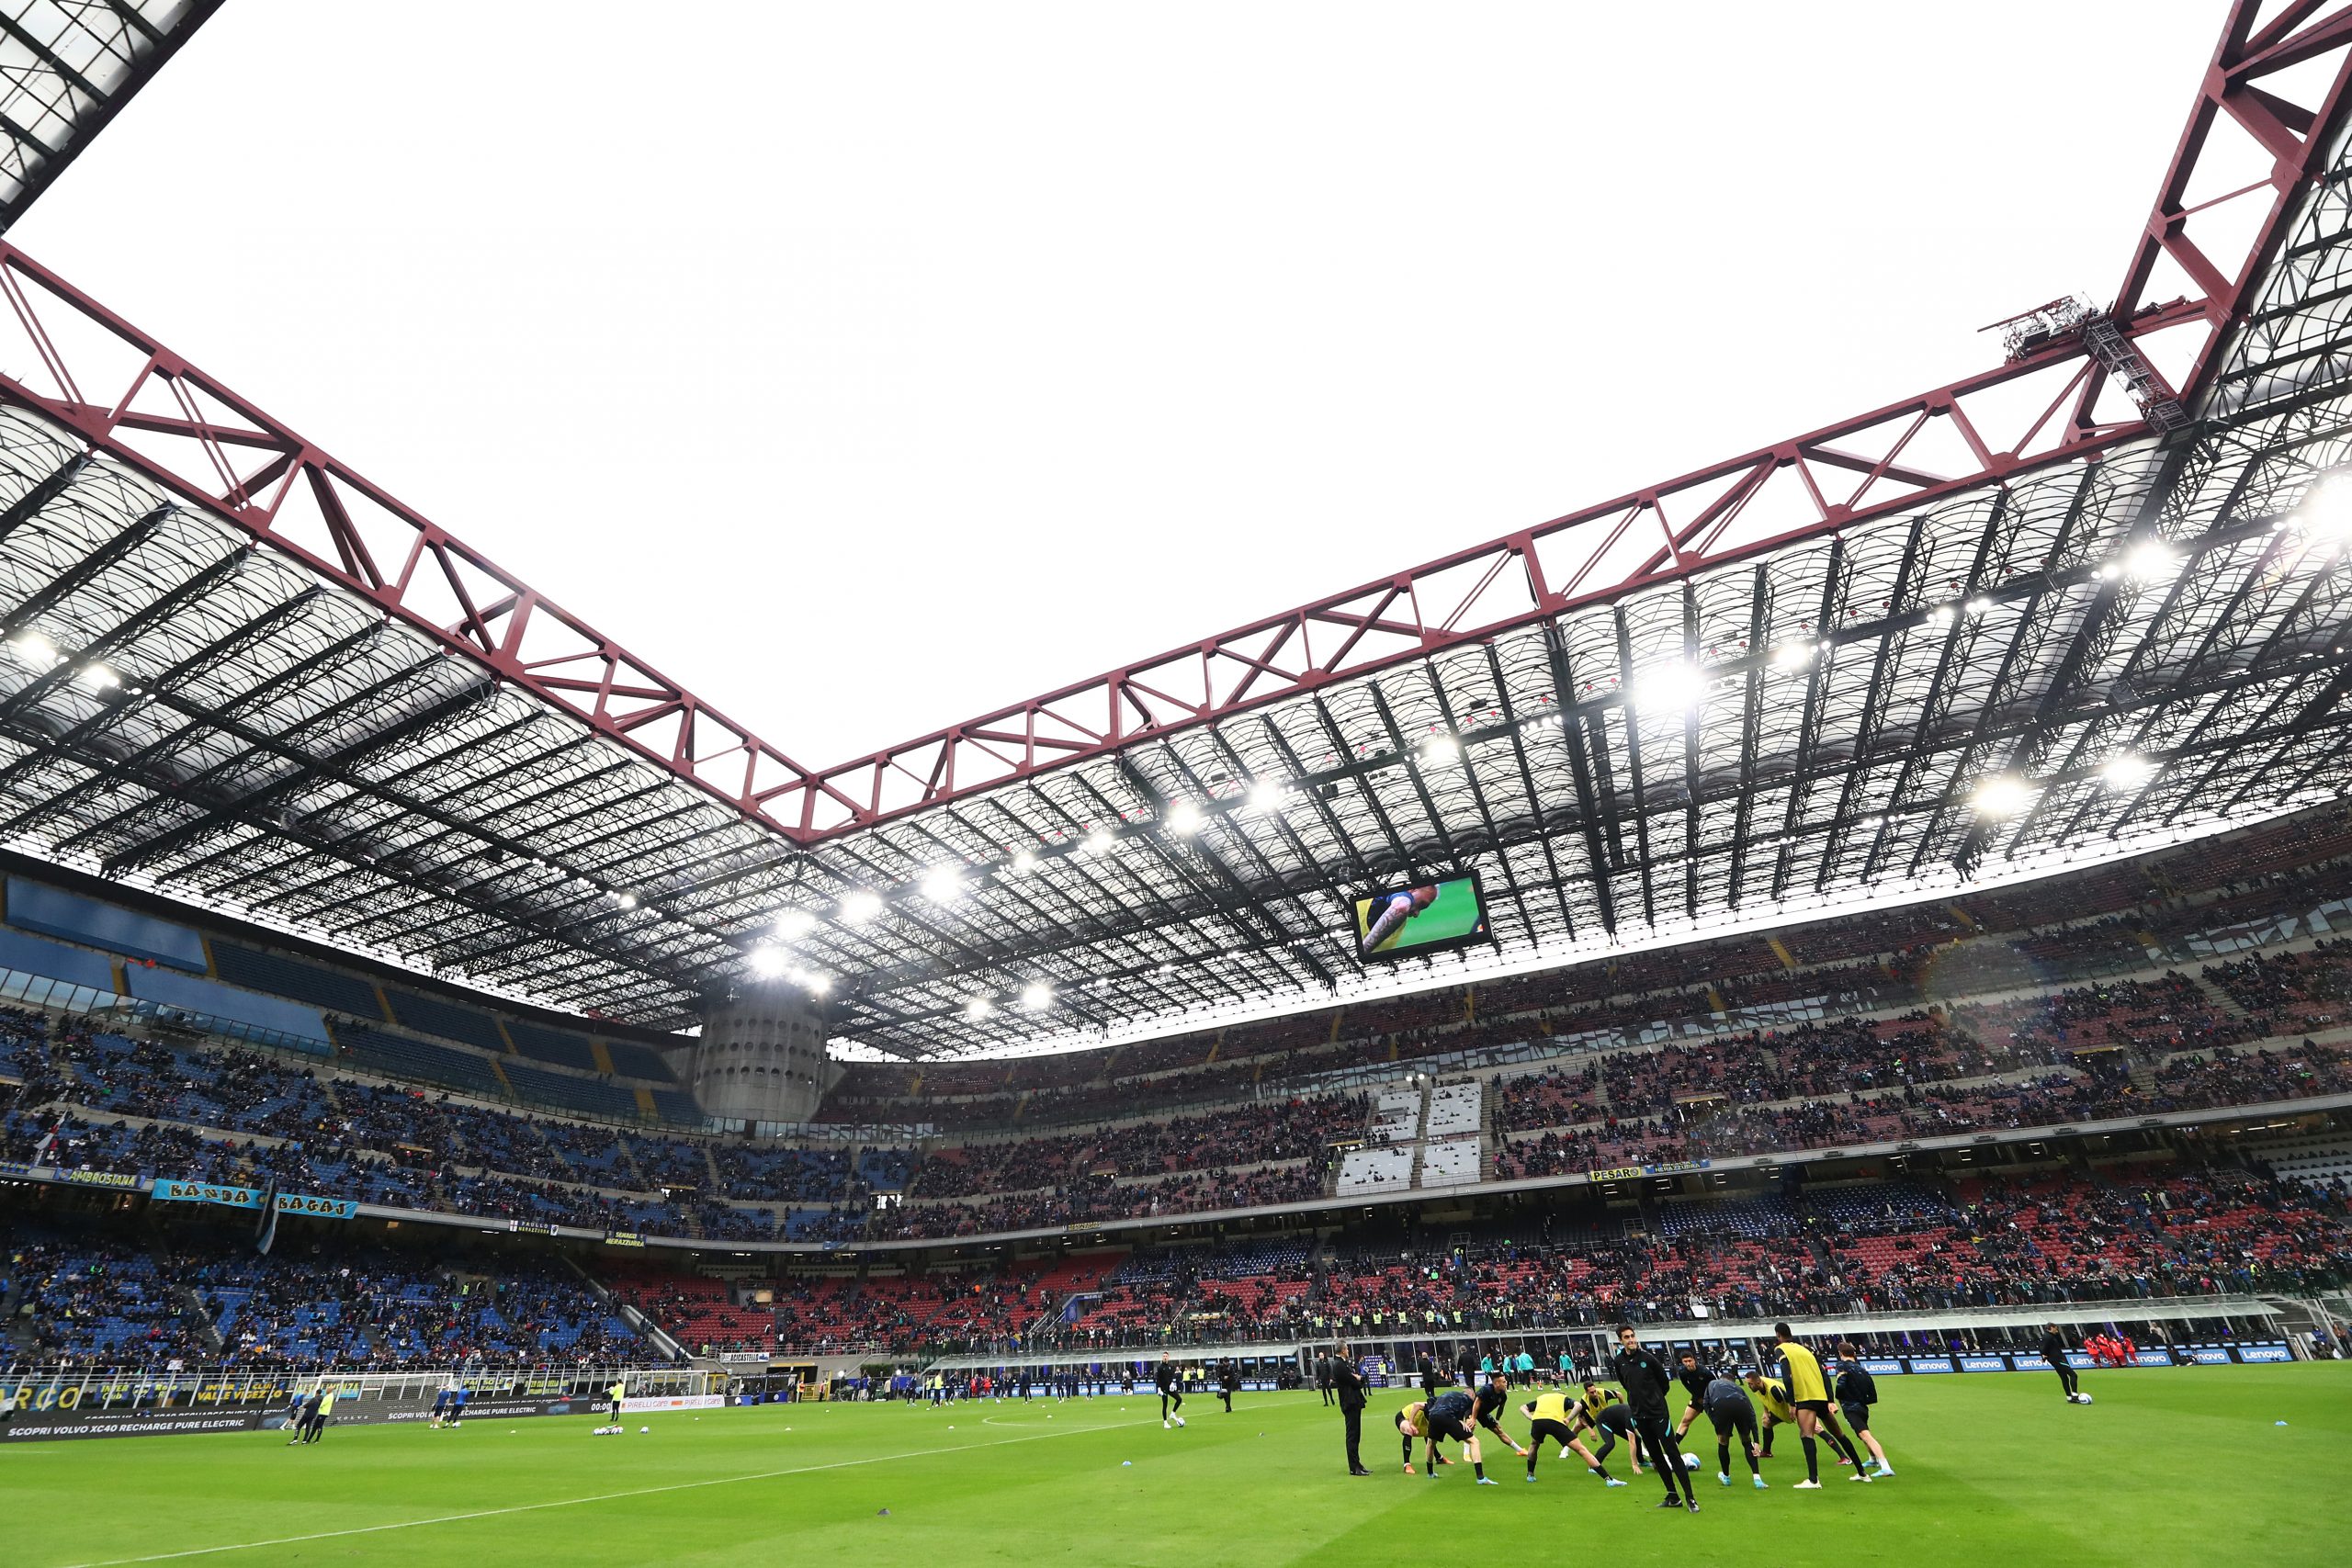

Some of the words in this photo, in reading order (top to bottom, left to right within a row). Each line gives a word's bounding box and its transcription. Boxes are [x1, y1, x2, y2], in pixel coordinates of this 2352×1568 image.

[69, 1170, 135, 1186] AMBROSIANA
[169, 1184, 250, 1205] BANDA
[2243, 1350, 2286, 1362] Lenovo
[1864, 1363, 1898, 1372] Lenovo
[1914, 1360, 1949, 1371] Lenovo
[1964, 1359, 2000, 1370] Lenovo
[101, 1385, 129, 1393] INER
[198, 1391, 232, 1401] VALE
[234, 1389, 283, 1400] VIGEZO
[102, 1393, 122, 1401] Cub
[628, 1400, 652, 1409] PIRELLI
[684, 1396, 707, 1405] PIRELI
[388, 1412, 414, 1420] SCOPRI
[415, 1411, 435, 1419] VOLV
[458, 1407, 490, 1416] ECHARGE
[492, 1406, 508, 1415] PURE
[508, 1405, 537, 1414] ELECTRIC
[591, 1403, 611, 1411] 00:00
[7, 1427, 51, 1437] SCOPRI
[53, 1425, 89, 1435] VOLVO
[90, 1424, 118, 1433] XC40
[119, 1421, 173, 1432] RECHARGE
[175, 1420, 200, 1429] PURE
[201, 1418, 244, 1428] ELECTRIC
